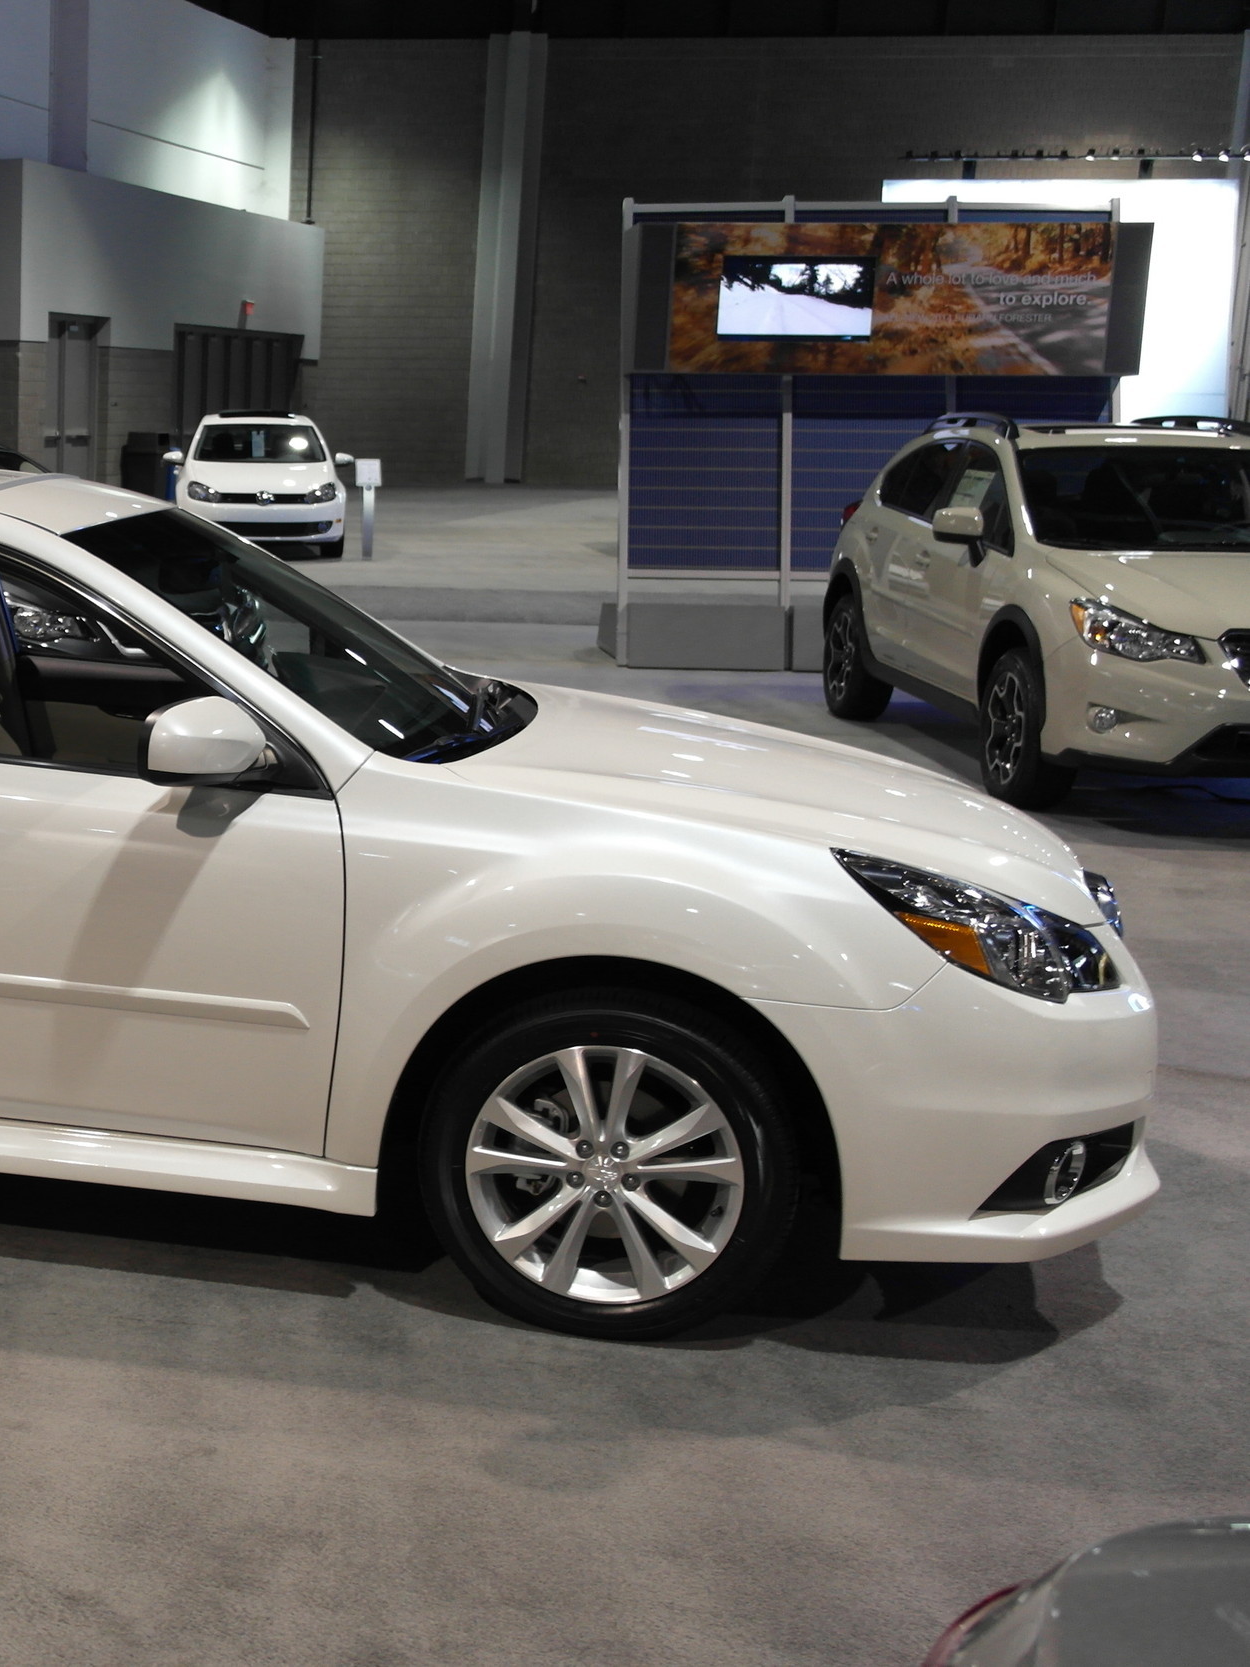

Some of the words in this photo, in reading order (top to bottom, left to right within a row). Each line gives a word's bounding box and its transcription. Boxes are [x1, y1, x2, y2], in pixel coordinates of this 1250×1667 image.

[886, 272, 898, 285] A
[902, 272, 945, 286] whole
[948, 272, 967, 286] lot
[971, 273, 985, 285] to
[989, 273, 1019, 285] love
[1023, 273, 1050, 285] and
[1054, 272, 1097, 285] much
[999, 293, 1016, 305] to
[1021, 291, 1091, 308] explore.
[999, 313, 1052, 323] FORESTER
